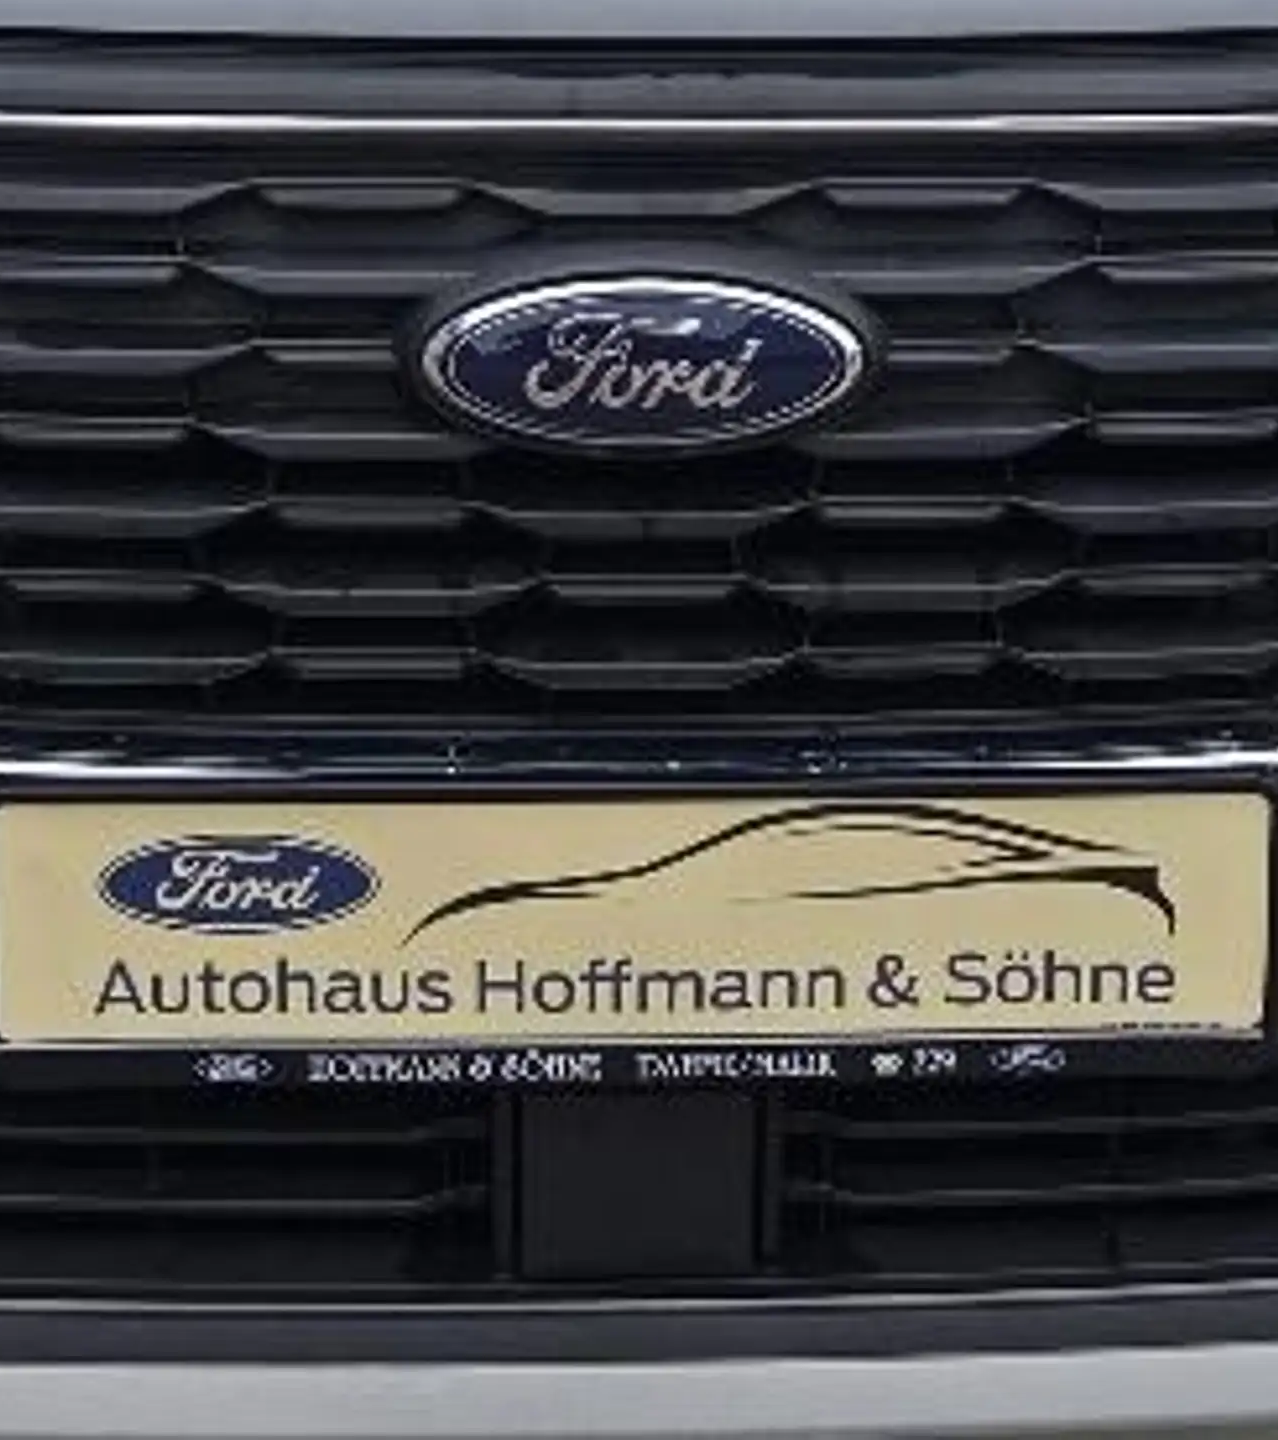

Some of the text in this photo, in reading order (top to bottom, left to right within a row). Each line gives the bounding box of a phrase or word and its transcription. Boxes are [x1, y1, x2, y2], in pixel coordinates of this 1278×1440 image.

[524, 312, 762, 409] Ford
[155, 850, 320, 912] Ford
[94, 948, 1176, 1016] Autohaus Hoffmann & Söhne
